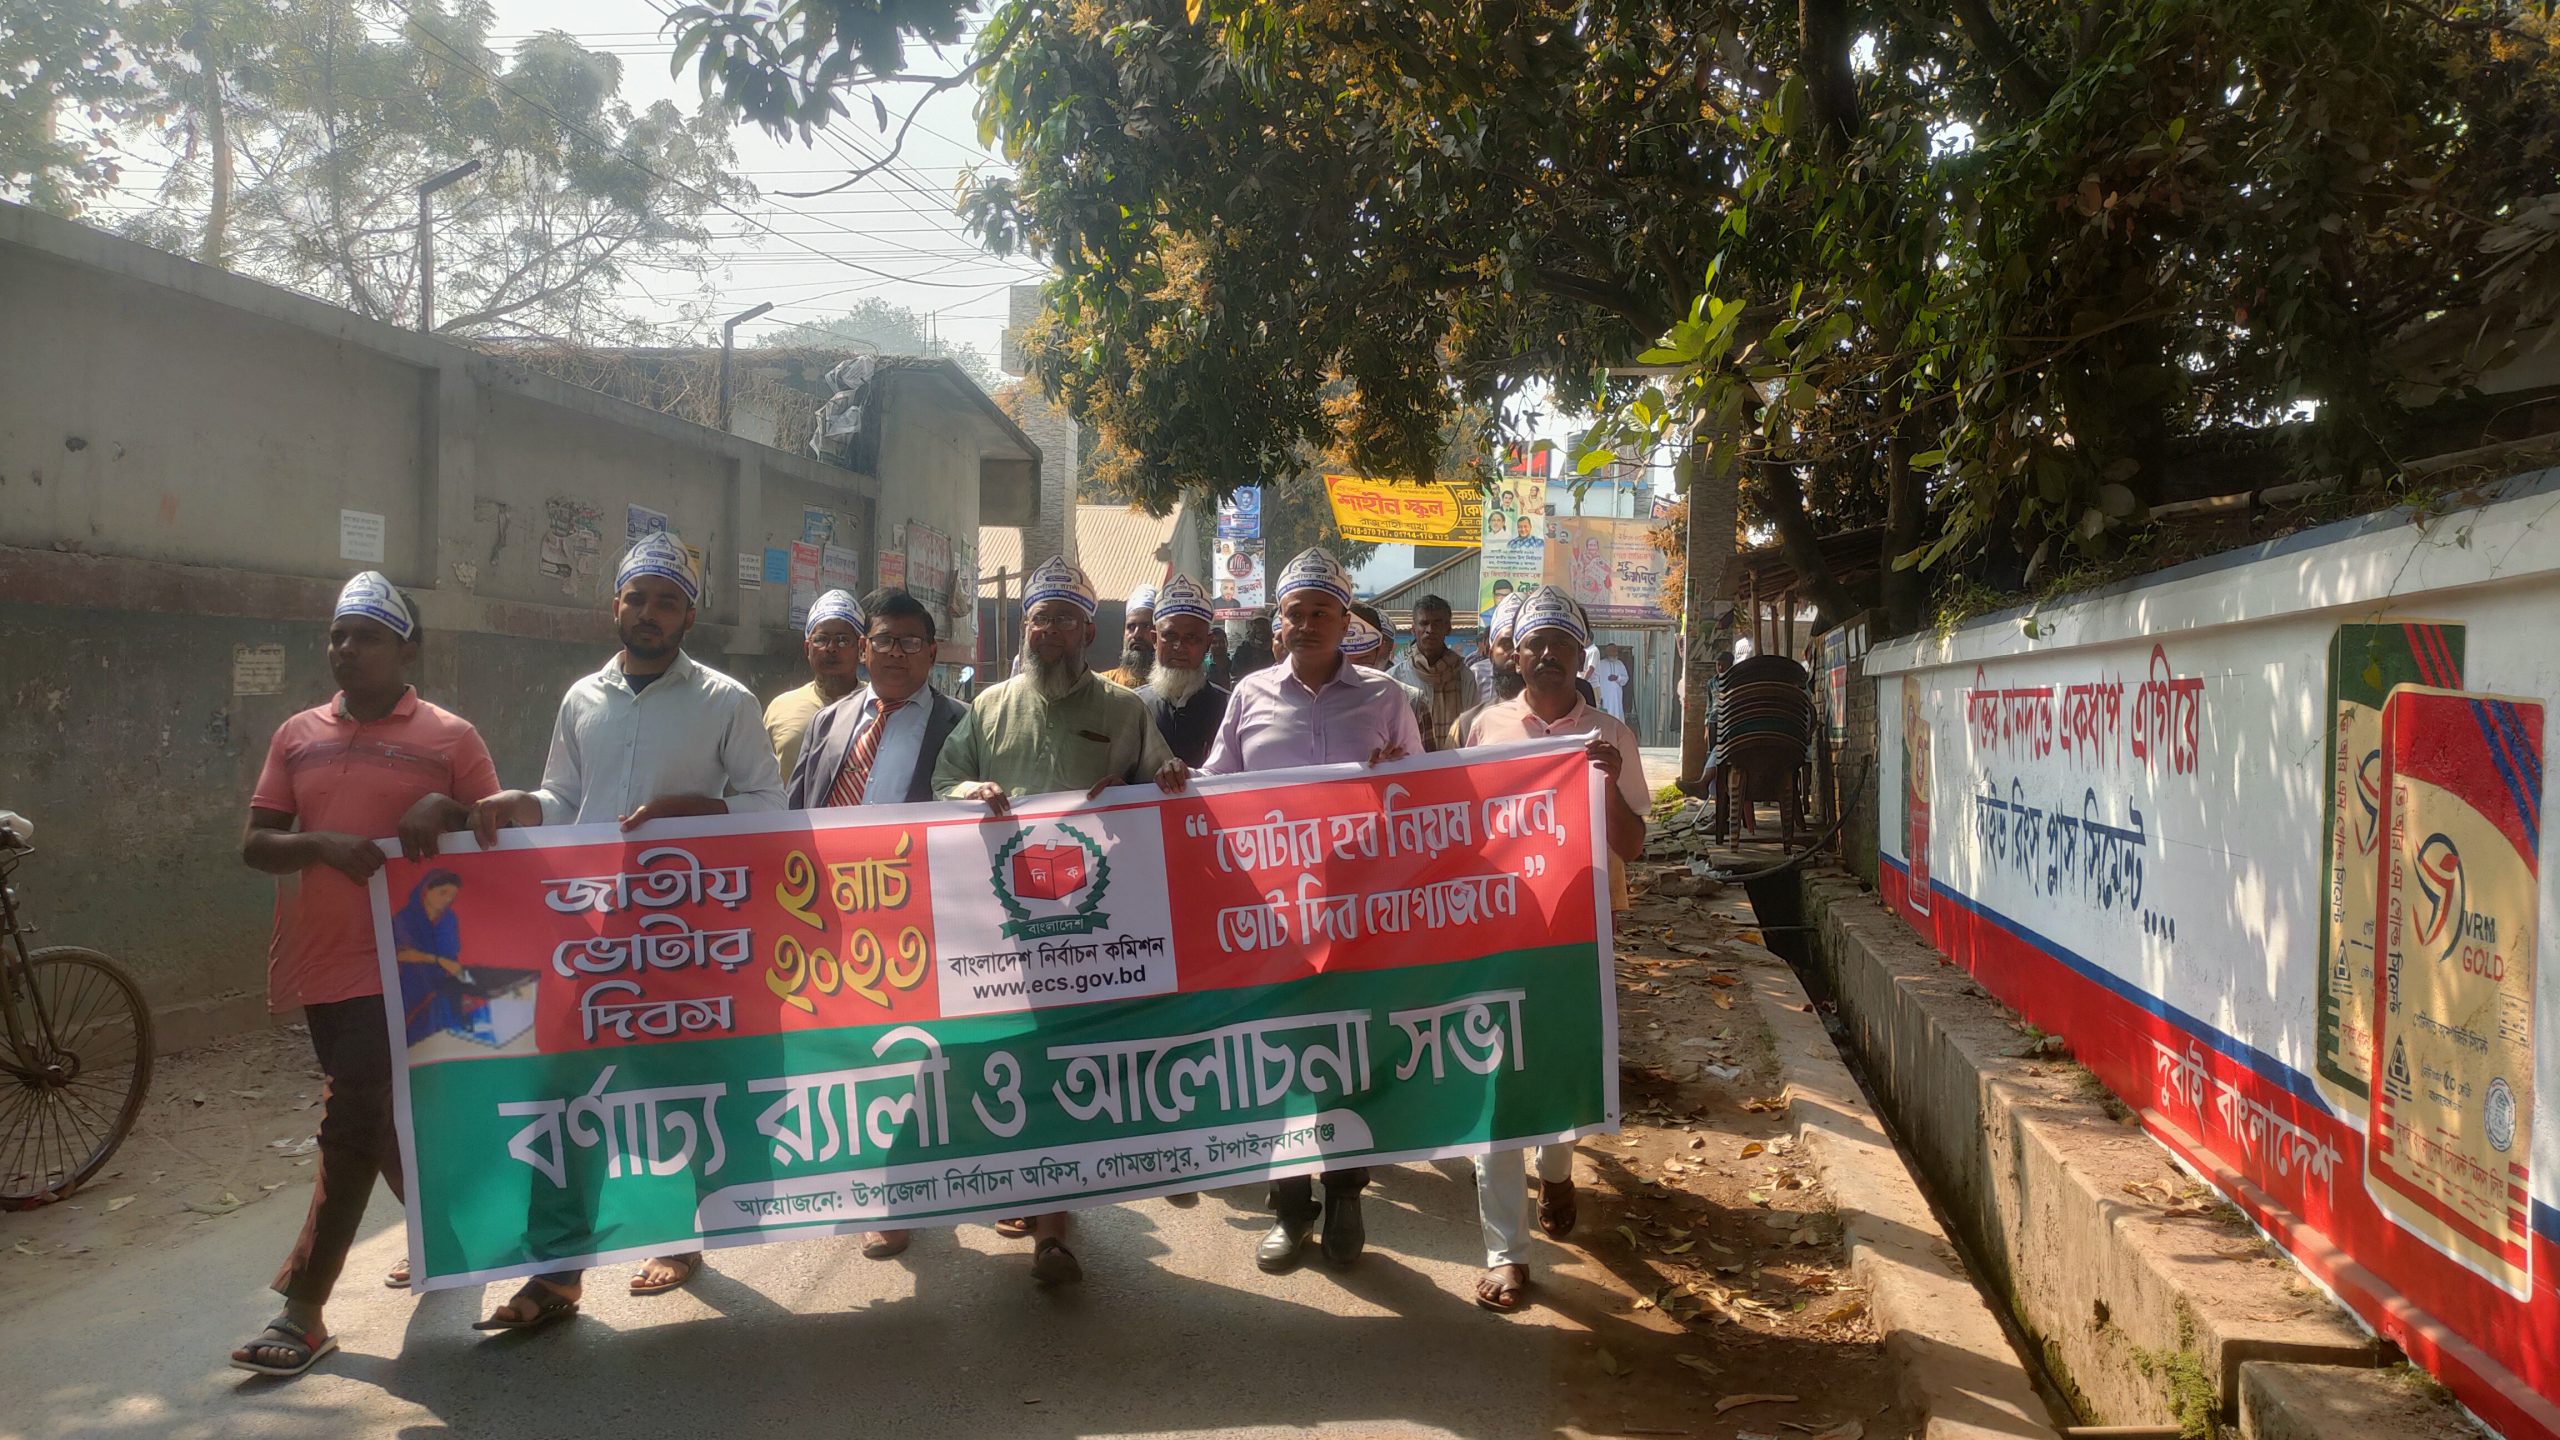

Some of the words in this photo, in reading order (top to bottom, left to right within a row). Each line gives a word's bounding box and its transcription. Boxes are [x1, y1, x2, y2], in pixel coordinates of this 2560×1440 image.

[1336, 492, 1400, 515] শাহীন
[1404, 499, 1444, 518] স্কুল
[2060, 670, 2124, 772] একধাপ
[2132, 644, 2205, 781] এগিয়ে
[1332, 810, 1380, 862] হব
[1383, 782, 1472, 861] নিয়ম
[1481, 788, 1567, 848] মেনে,
[2336, 779, 2347, 810] এম
[2391, 813, 2405, 852] আর
[541, 847, 749, 914] জাতীয়
[776, 849, 824, 930] ২
[828, 830, 911, 913] মার্চ
[1064, 866, 1079, 879] ক
[2390, 859, 2402, 890] এম
[1026, 918, 1084, 936] বাংলাদেশ
[1216, 891, 1289, 954] ভোট
[1299, 874, 1357, 946] দিব
[2463, 911, 2496, 944] VRM
[551, 914, 751, 978] ভোটার
[765, 925, 928, 1014] ২০২৩
[948, 946, 1033, 978] বাংলাদেশ
[1037, 938, 1099, 969] নির্বাচন
[1103, 933, 1166, 962] কমিশন
[2463, 945, 2504, 982] GOLD
[578, 980, 735, 1043] দিবস
[973, 964, 1146, 1000] www.ecs.gov.bd
[2387, 952, 2404, 1019] সিমেন্ট
[497, 1064, 727, 1189] বর্ণাঢ্য
[748, 1025, 950, 1168] র‍্যালী
[972, 1050, 1028, 1138] ও
[1047, 1008, 1373, 1124] আলোচনা
[1388, 988, 1527, 1086] সভা
[2152, 1039, 2211, 1138] দুবাই
[2212, 1076, 2343, 1213] বাংলাদেশ
[734, 1192, 843, 1218] আয়োজনে:
[851, 1173, 938, 1208] উপজেলা
[944, 1167, 1014, 1198] নির্বাচন
[1018, 1156, 1089, 1188] অফিস,
[1095, 1144, 1199, 1181] গোমস্তাপুর,
[1207, 1120, 1337, 1166] চাঁপাইনবাবগঞ্জ
